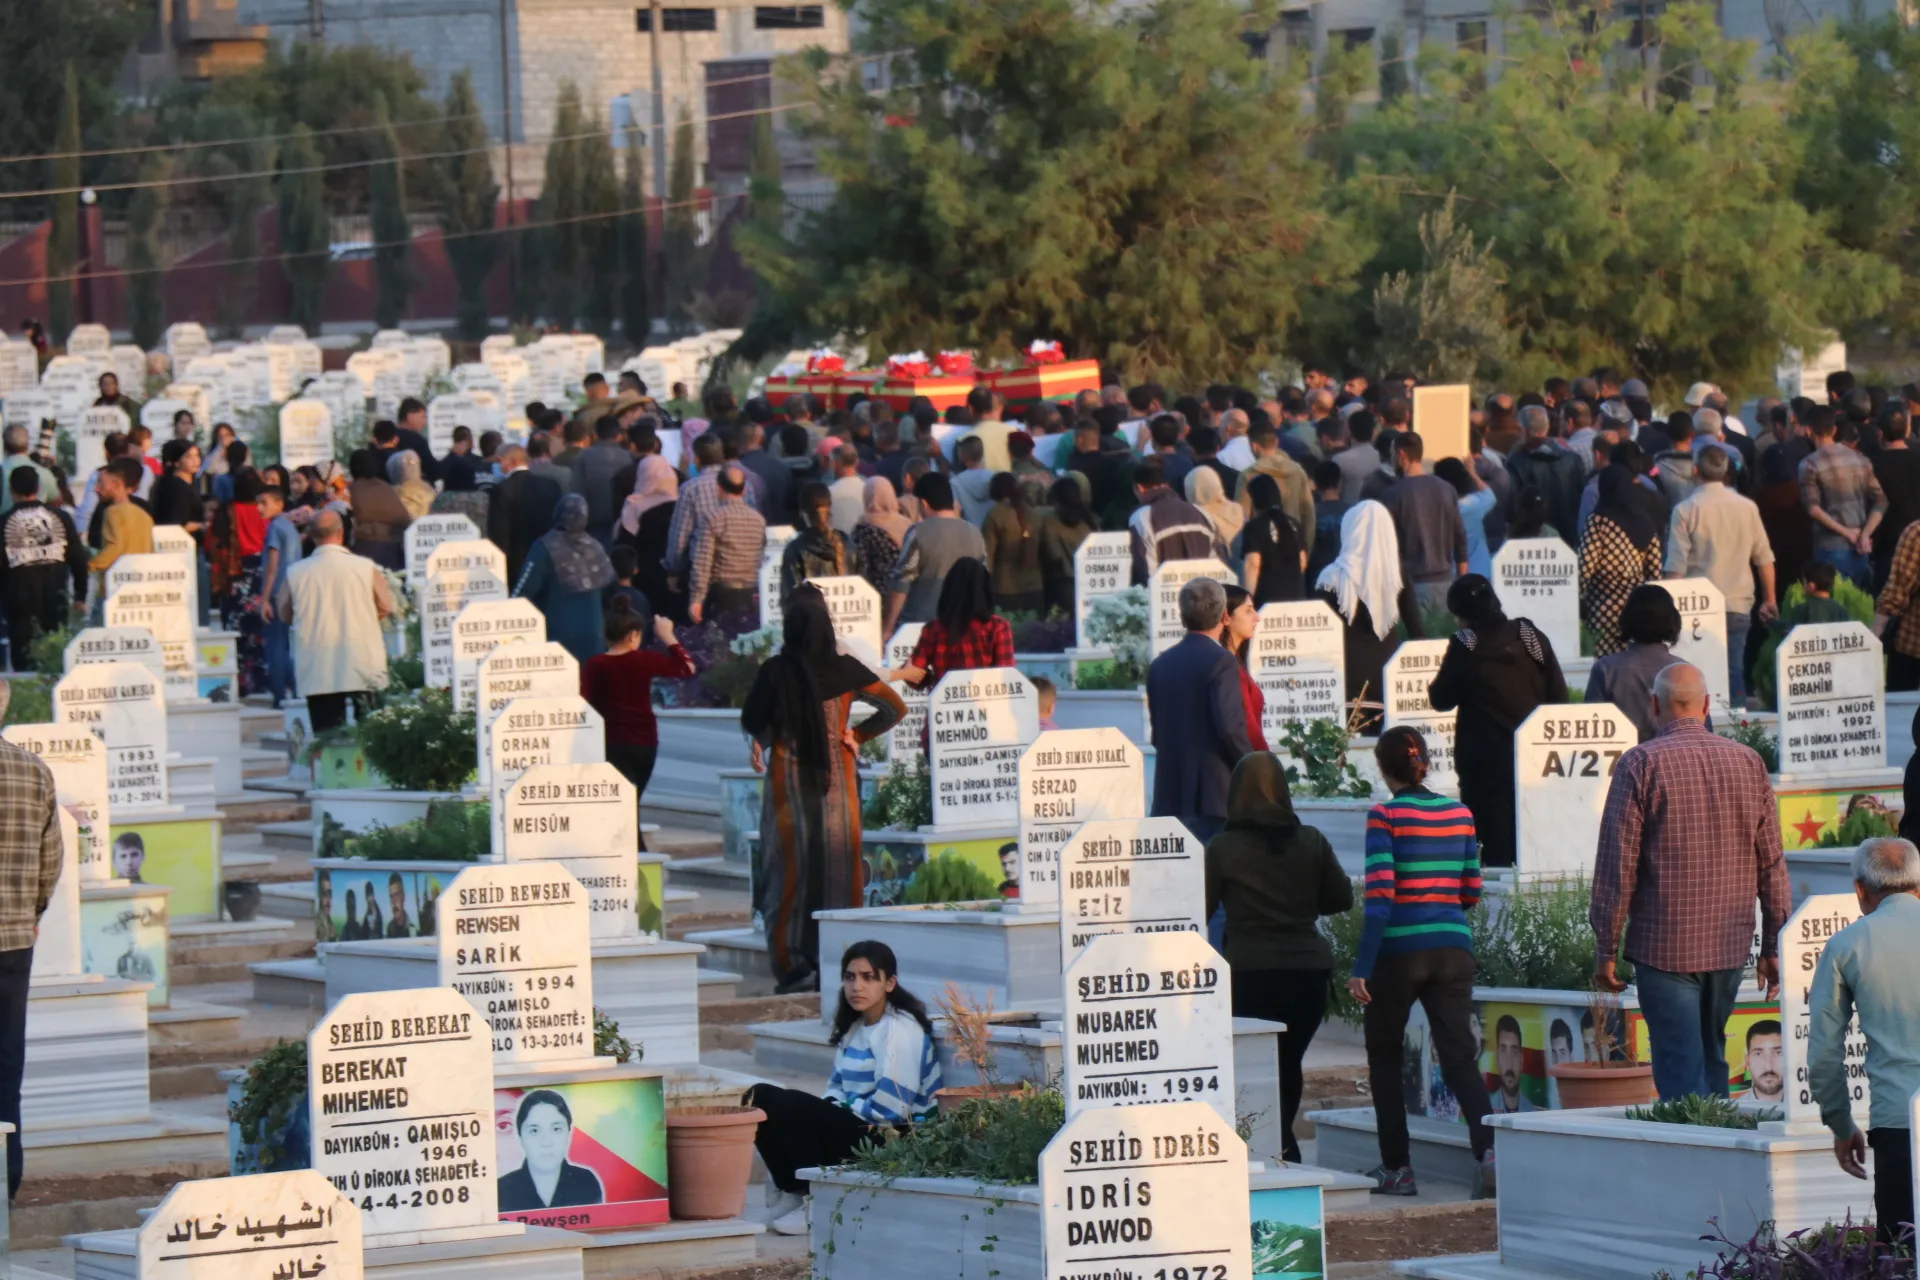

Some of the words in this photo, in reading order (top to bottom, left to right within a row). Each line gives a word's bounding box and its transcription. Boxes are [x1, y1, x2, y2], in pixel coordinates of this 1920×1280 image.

[1085, 564, 1119, 574] OSMAN
[1259, 655, 1297, 667] TEMO
[1787, 662, 1832, 680] ÇEKDAR
[985, 682, 1023, 696] GABAR
[1304, 690, 1331, 701] 1995
[935, 708, 987, 724] CIWAN
[1842, 715, 1872, 727] 1992
[936, 726, 988, 744] MEHMÛD
[49, 738, 92, 753] ZINAR
[502, 736, 550, 752] ORHAN
[119, 750, 154, 761] 1993
[1541, 750, 1623, 778] A/27
[1791, 751, 1806, 763] TEL
[1811, 749, 1838, 761] BIRAK
[996, 763, 1017, 773] 199
[940, 782, 954, 793] CIH
[955, 780, 961, 791] Û
[940, 796, 958, 807] TEL
[962, 793, 992, 804] BIRAK
[513, 813, 570, 834] MEISÛM
[1028, 852, 1042, 863] CIH
[1030, 871, 1046, 882] TIL
[456, 915, 520, 935] REWŞEN
[525, 975, 575, 991] 1994
[1160, 962, 1218, 990] EGÎD
[488, 997, 550, 1014] QAMIŞLO
[391, 1013, 471, 1039] BEREKAT
[1076, 1008, 1157, 1035] MUBAREK
[521, 1032, 583, 1049] 13-3-2014
[1077, 1039, 1160, 1066] MUHEMED
[321, 1056, 407, 1084] BEREKAT
[1163, 1075, 1219, 1095] 1994
[322, 1087, 408, 1115] MIHEMED
[407, 1119, 481, 1144] QAMIŞLO
[1152, 1126, 1220, 1159] IDRÎS
[420, 1143, 468, 1161] 1946
[351, 1170, 360, 1189] Û
[1067, 1177, 1152, 1211] IDRÎS
[167, 1213, 227, 1243] خالد
[1067, 1217, 1153, 1247] DAWOD
[1153, 1265, 1228, 1280] 1972
